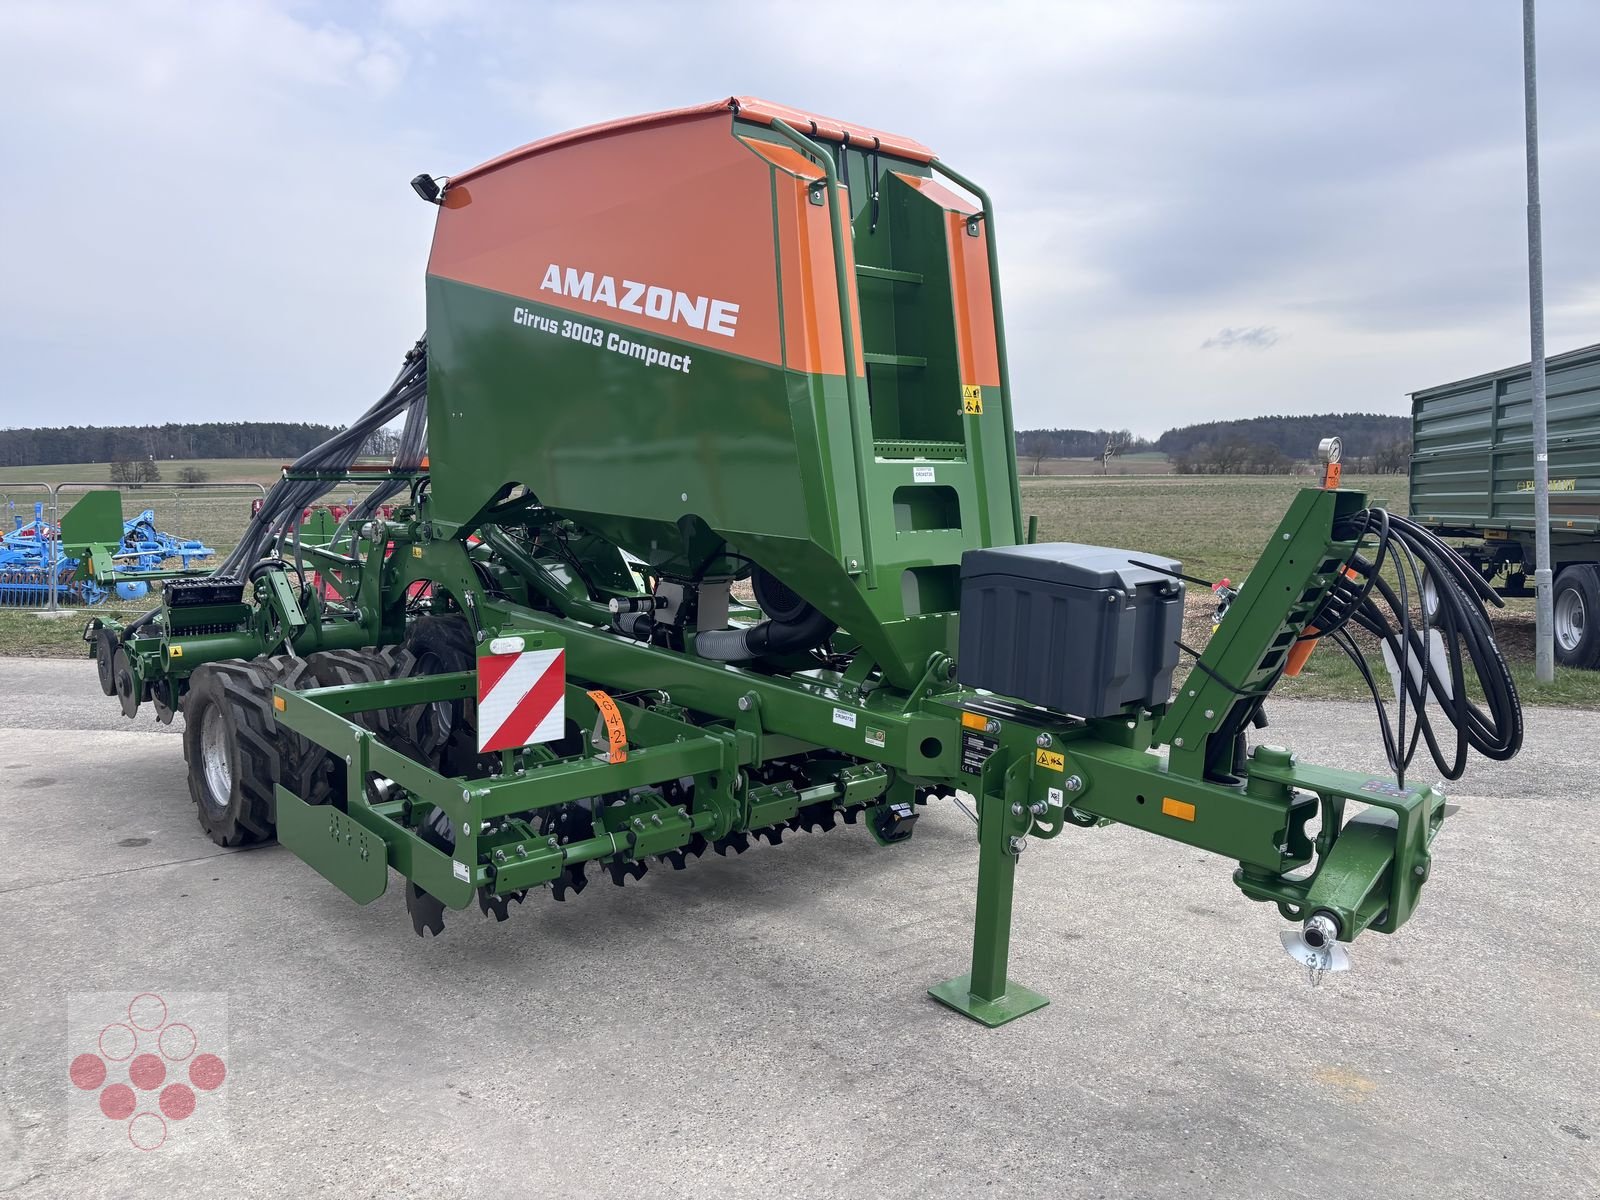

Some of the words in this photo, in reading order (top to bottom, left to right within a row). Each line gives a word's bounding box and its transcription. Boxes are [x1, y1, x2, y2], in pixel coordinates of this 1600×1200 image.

[540, 264, 740, 337] AMAZONE
[513, 306, 558, 334] Cirrus
[561, 319, 604, 347] 3003
[607, 332, 692, 374] Compact
[1526, 478, 1577, 491] FMANN
[603, 701, 612, 710] 6
[610, 713, 618, 726] 4
[614, 730, 622, 744] 2
